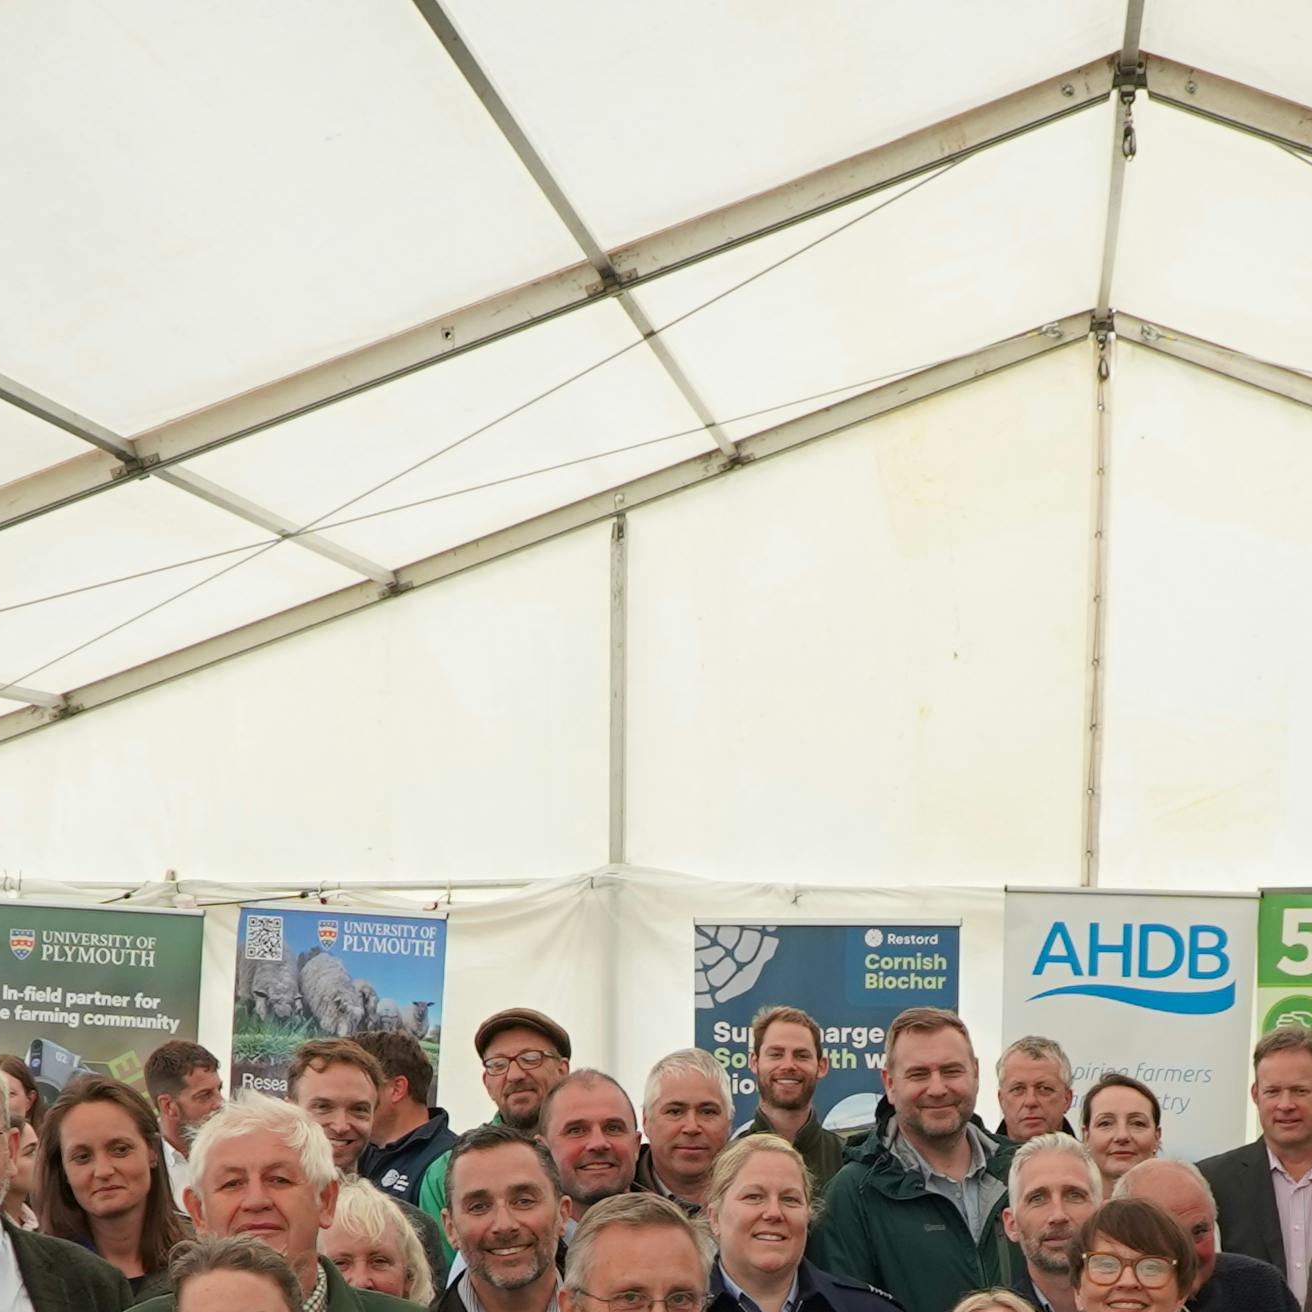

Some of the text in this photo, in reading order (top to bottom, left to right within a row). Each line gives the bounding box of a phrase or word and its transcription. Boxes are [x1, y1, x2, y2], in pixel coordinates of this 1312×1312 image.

[42, 930, 157, 950] UNIVERSITY OF
[344, 921, 437, 940] UNIVERSITY OF
[887, 933, 938, 945] Restord
[41, 944, 156, 968] PLYMOUTH
[343, 935, 436, 957] PLYMOUTH
[1032, 921, 1230, 980] AHDB
[864, 952, 947, 971] Cornish
[865, 972, 946, 990] Biochar
[3, 984, 161, 1010] In-field partner for
[14, 1005, 80, 1028] farming
[83, 1012, 180, 1034] community
[242, 1072, 288, 1092] Resea
[1135, 1062, 1213, 1083] farmers
